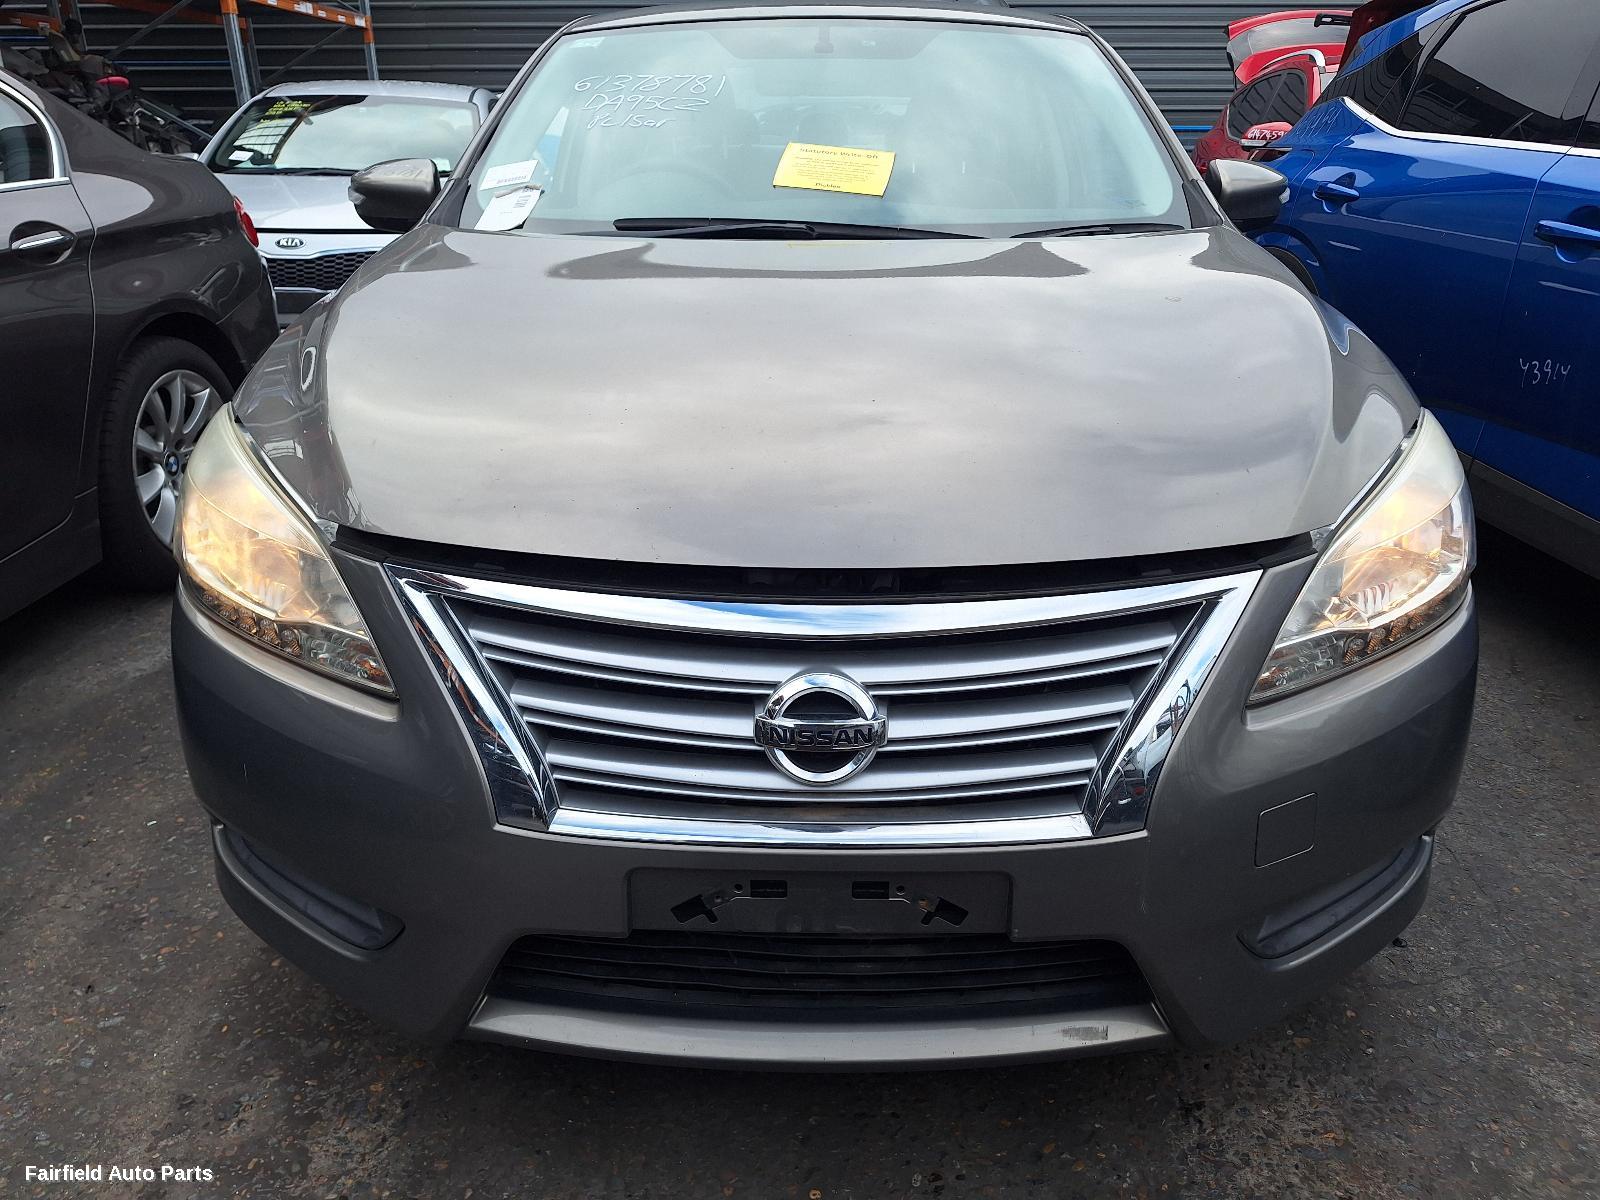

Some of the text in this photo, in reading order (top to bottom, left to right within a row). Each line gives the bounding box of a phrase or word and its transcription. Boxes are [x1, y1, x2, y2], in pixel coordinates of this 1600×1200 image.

[574, 74, 726, 97] 61378781
[279, 237, 302, 247] KIA
[769, 727, 872, 747] NISSAN
